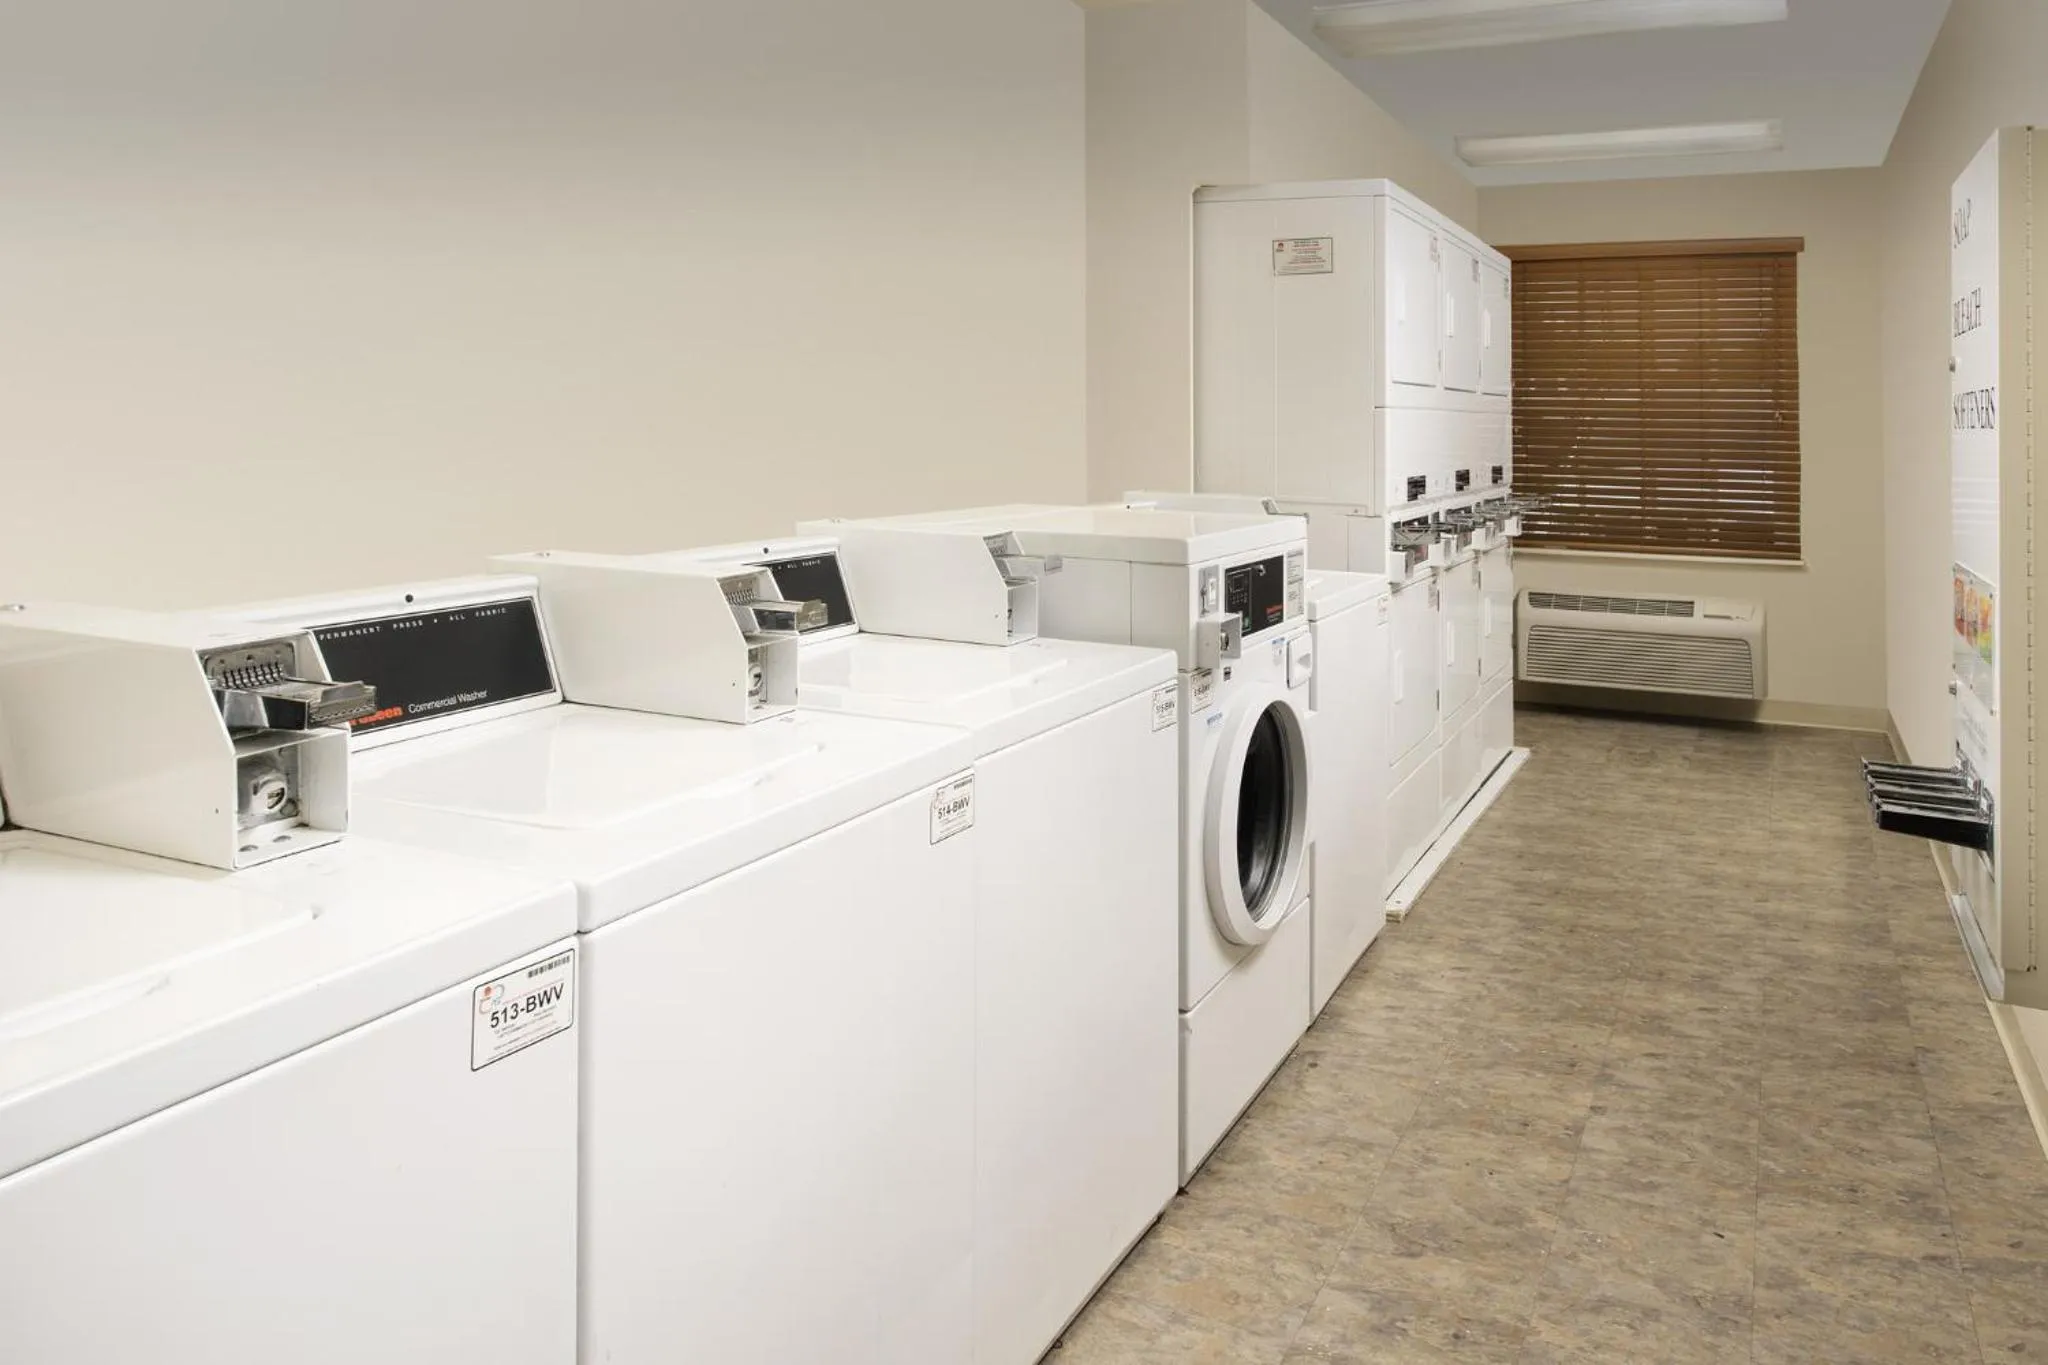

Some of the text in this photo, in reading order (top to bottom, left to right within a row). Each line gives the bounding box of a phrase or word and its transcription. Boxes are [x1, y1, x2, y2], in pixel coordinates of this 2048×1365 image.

[320, 626, 381, 640] PERMANENT
[408, 694, 457, 714] Commercial
[457, 689, 488, 703] Washer
[490, 982, 565, 1029] 513-BWV
